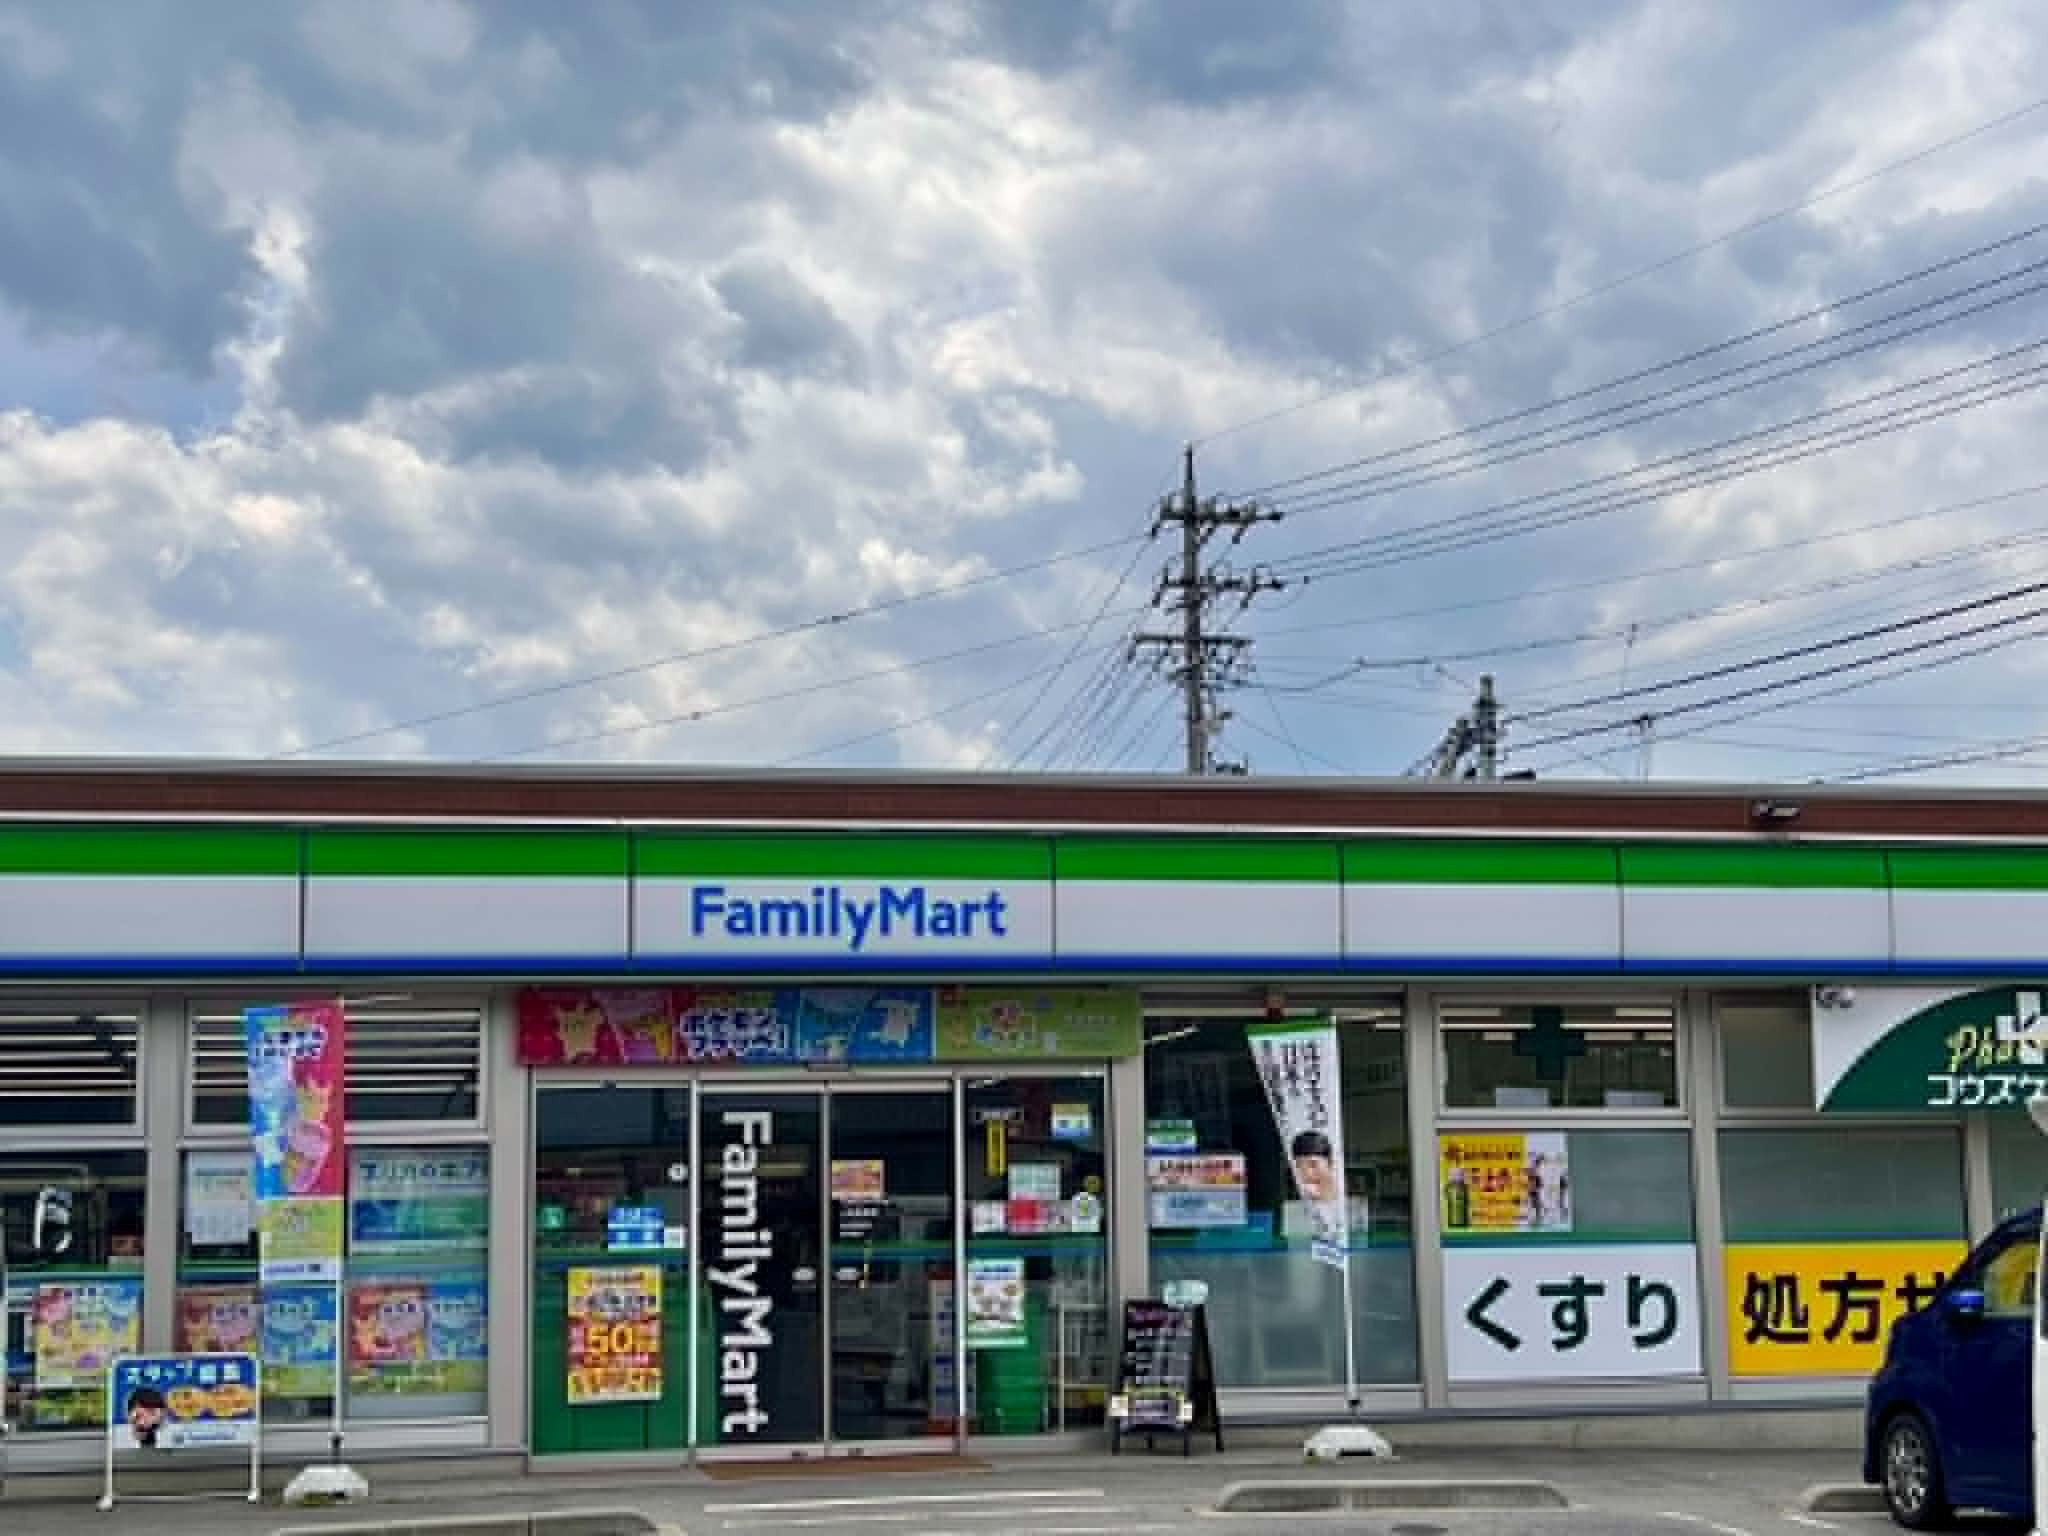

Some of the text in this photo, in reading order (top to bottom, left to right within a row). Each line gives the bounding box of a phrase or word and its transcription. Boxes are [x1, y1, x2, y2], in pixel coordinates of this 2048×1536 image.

[691, 886, 1008, 951] FamilyMart
[705, 1111, 773, 1433] FamilyMart
[1466, 1274, 1680, 1351] くすり
